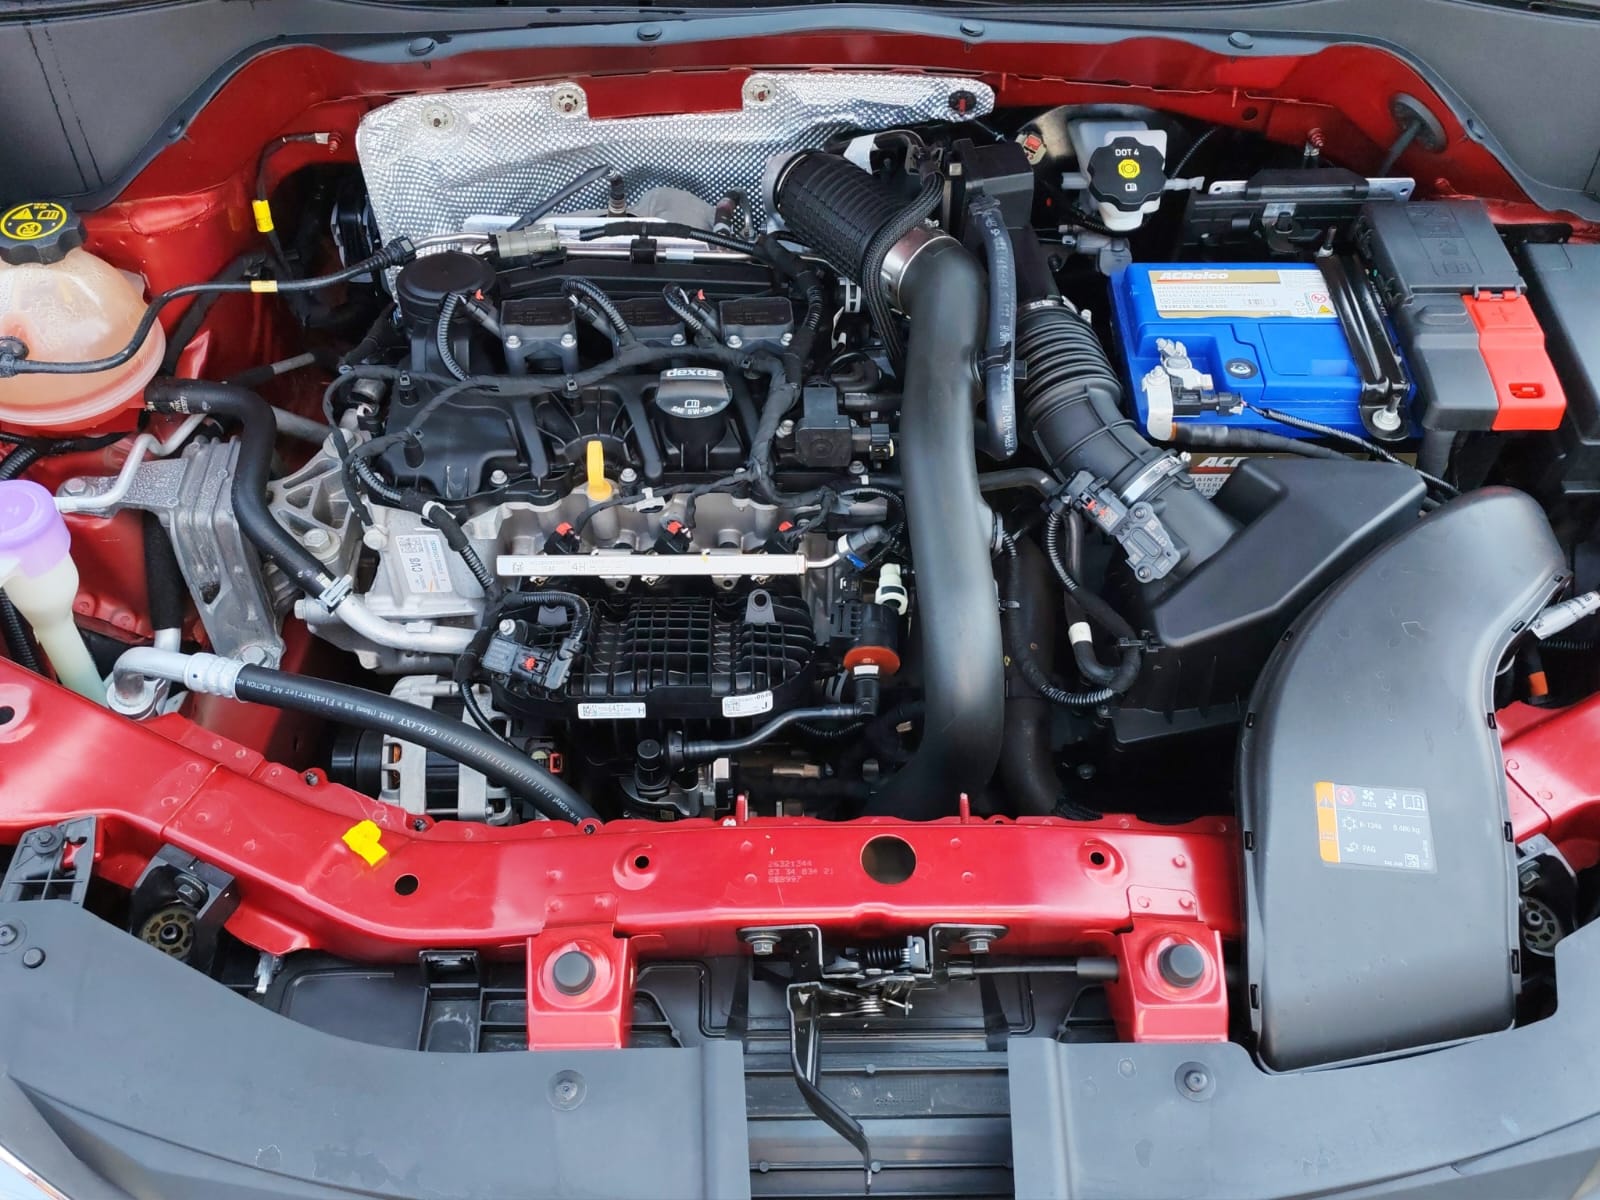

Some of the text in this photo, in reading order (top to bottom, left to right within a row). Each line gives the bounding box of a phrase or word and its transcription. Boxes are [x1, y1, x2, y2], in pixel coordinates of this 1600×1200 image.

[1115, 148, 1140, 157] DOT 4
[1159, 271, 1229, 280] ACDelco
[666, 368, 717, 377] dexos
[246, 680, 271, 692] SUCTION
[399, 717, 438, 737] GALAXY
